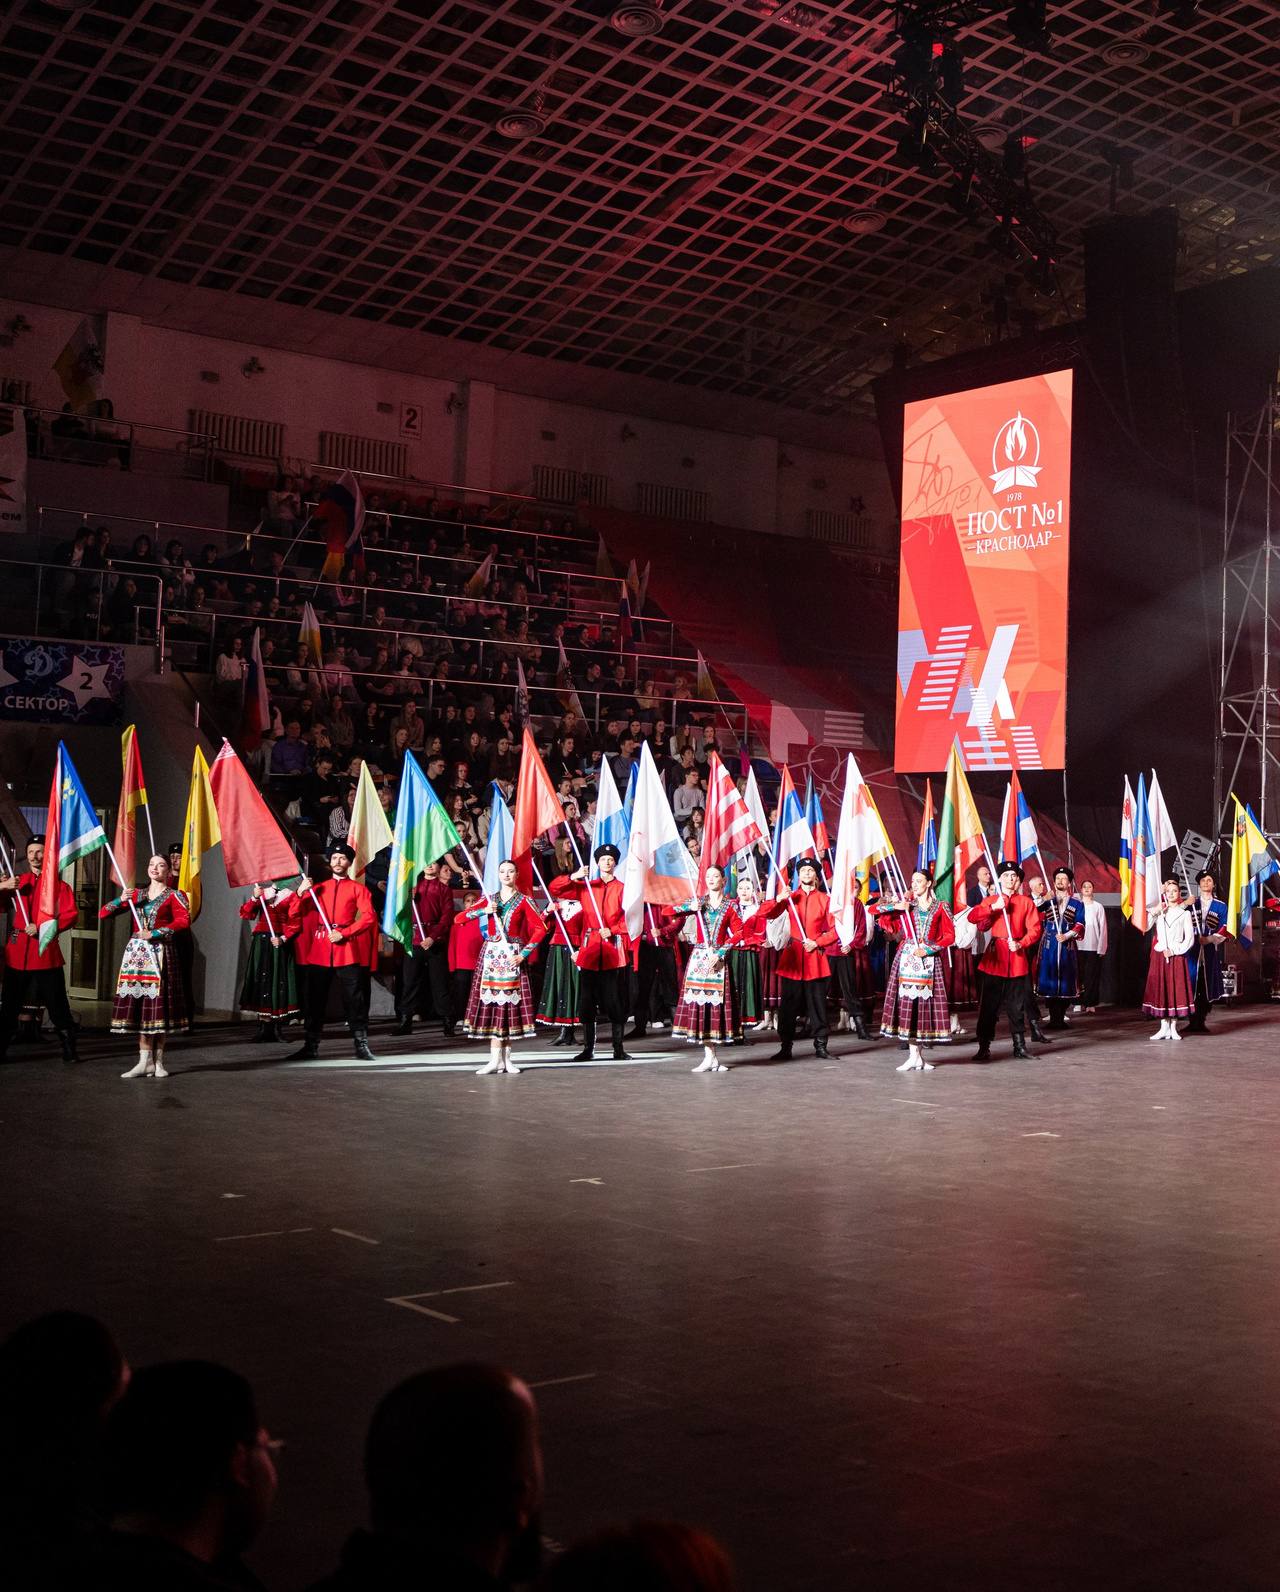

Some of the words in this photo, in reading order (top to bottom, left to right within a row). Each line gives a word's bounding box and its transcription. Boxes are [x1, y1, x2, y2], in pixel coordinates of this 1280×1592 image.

[405, 408, 417, 429] 2
[1006, 492, 1022, 502] 1978
[967, 505, 1027, 536] ПОСТ
[1031, 499, 1063, 527] №1
[79, 672, 93, 690] 2
[4, 695, 69, 711] СЕКТОР
